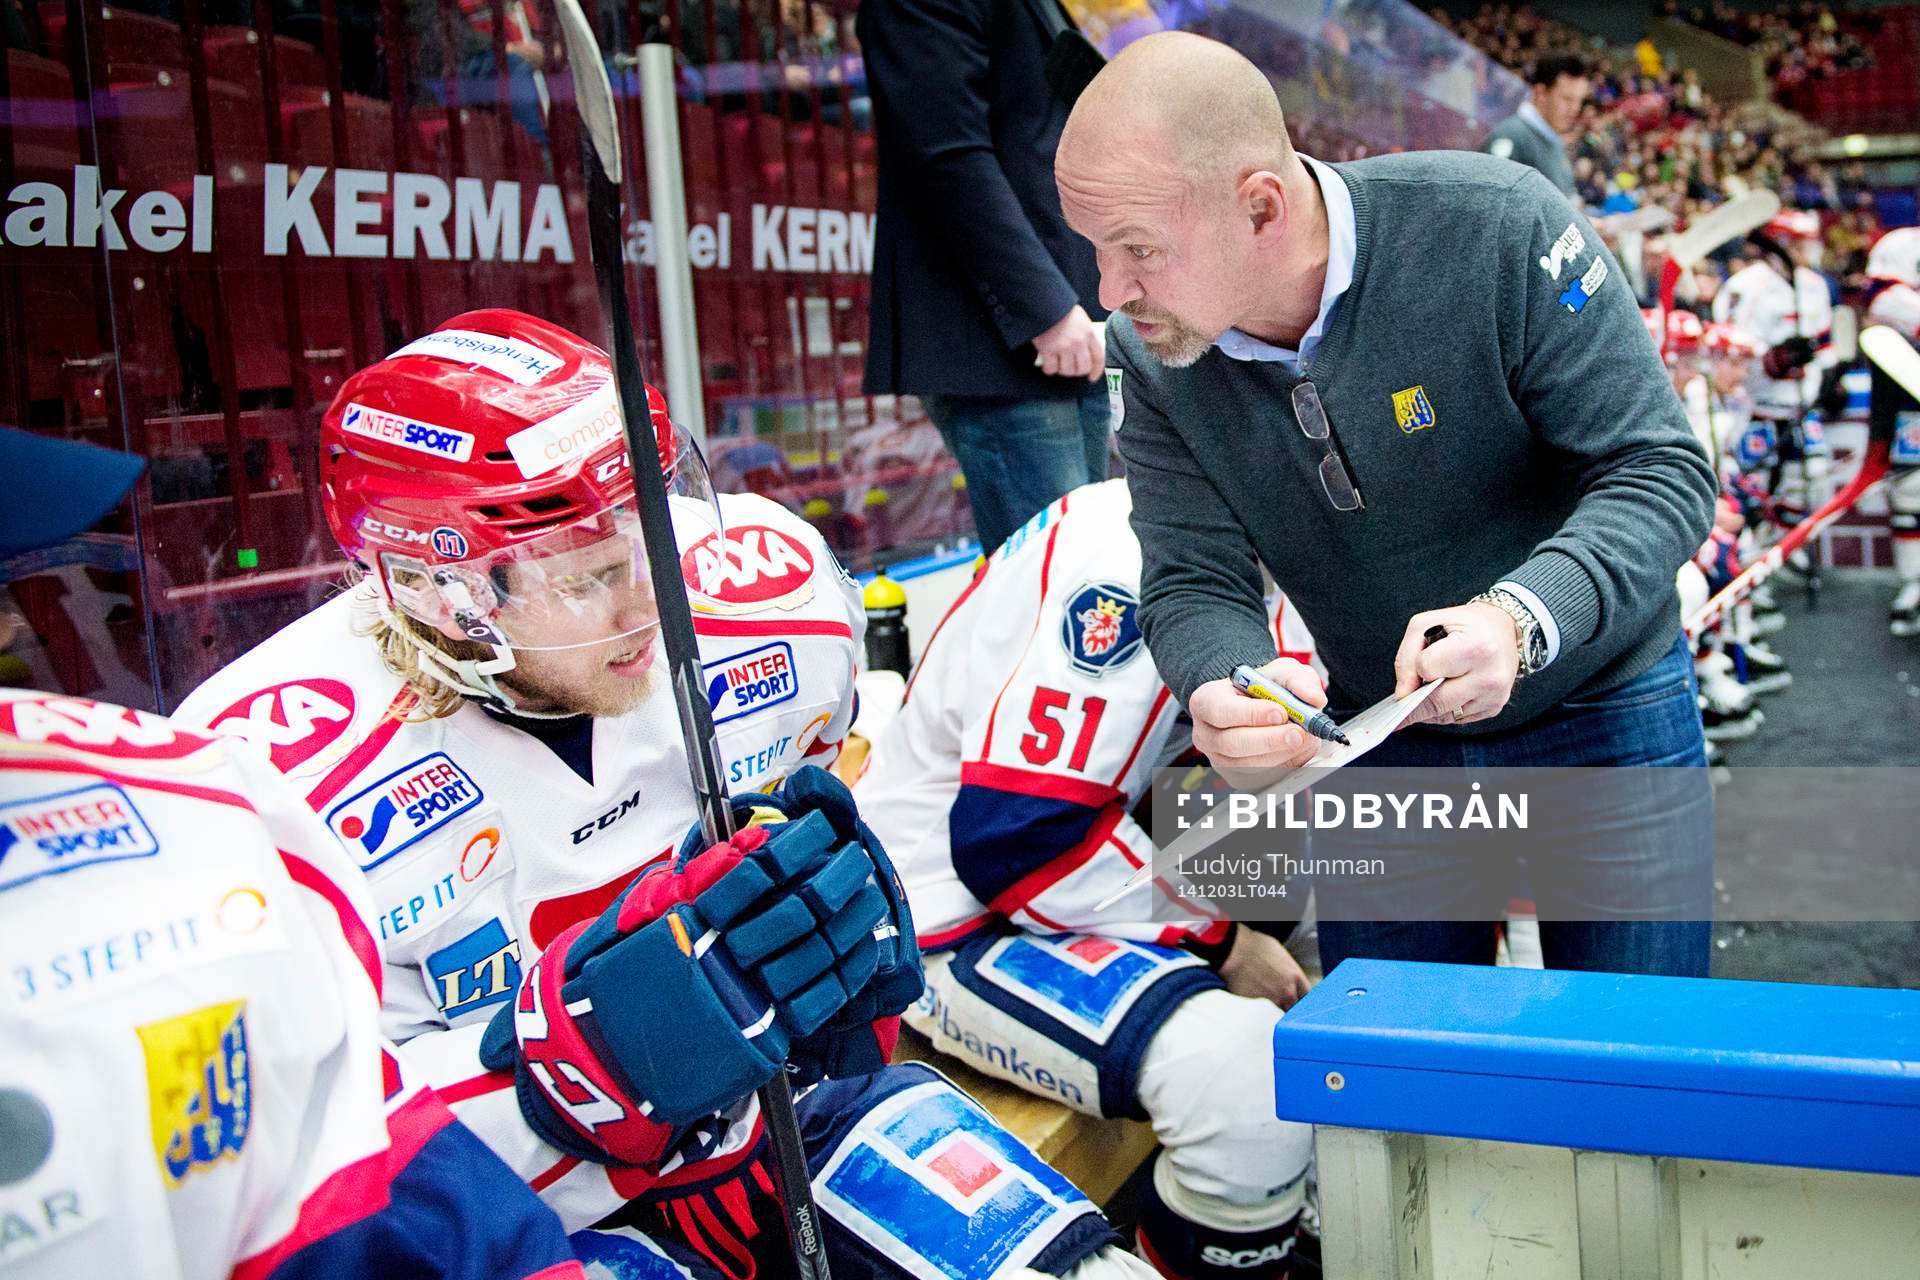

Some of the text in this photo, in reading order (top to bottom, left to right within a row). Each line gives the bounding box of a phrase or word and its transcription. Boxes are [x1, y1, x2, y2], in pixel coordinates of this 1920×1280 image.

[0, 163, 574, 263] akel KERMA
[620, 203, 731, 269] ael
[363, 516, 430, 545] CCM
[437, 533, 462, 556] 11
[694, 529, 811, 596] AXA
[728, 652, 788, 687] INTER
[734, 671, 790, 706] SPORT
[1019, 685, 1107, 773] 51
[391, 762, 458, 808] INTER
[405, 779, 471, 828] SPORT
[13, 799, 127, 837] INTER
[36, 823, 137, 858] SPORT
[570, 790, 640, 845] CCM
[433, 873, 456, 909] IT
[14, 917, 200, 1001] 3 STEP IT
[438, 938, 522, 1013] LT
[796, 1203, 818, 1256] Reebok
